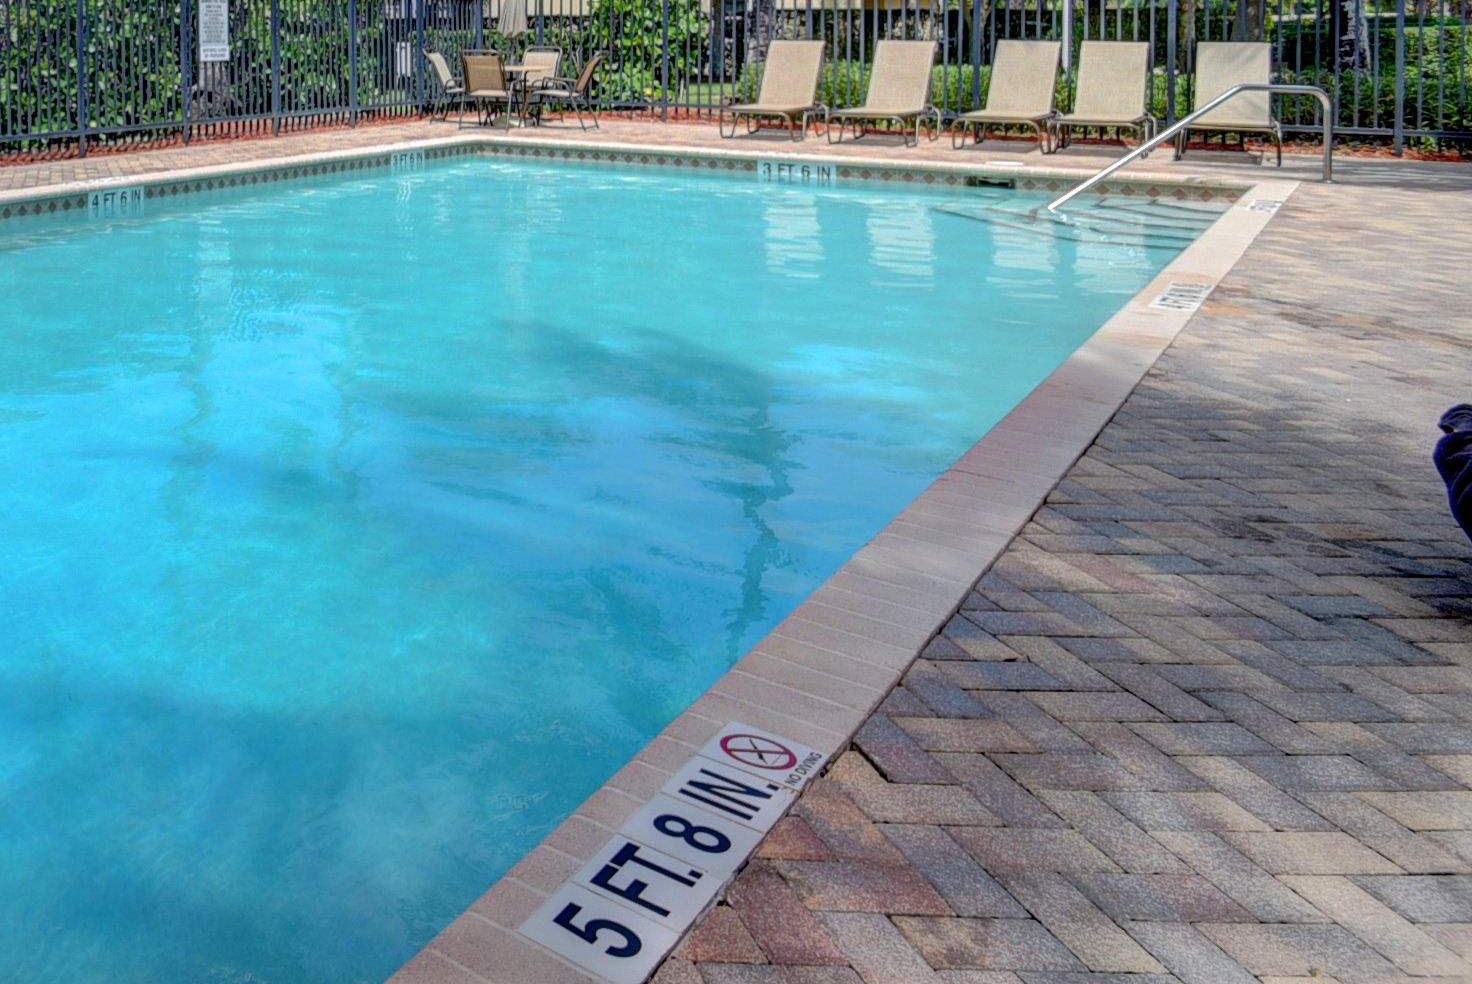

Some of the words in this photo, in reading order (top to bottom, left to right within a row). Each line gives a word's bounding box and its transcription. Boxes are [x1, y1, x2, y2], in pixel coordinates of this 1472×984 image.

[762, 162, 771, 175] 3
[778, 163, 794, 177] FT
[801, 165, 810, 177] 6
[817, 165, 831, 179] IN
[92, 194, 99, 206] 4
[103, 192, 116, 204] FT
[120, 190, 127, 204] 6
[131, 188, 141, 201] IN
[784, 774, 802, 786] NO
[794, 751, 823, 776] DIVING
[552, 901, 643, 958] 5
[652, 813, 731, 854] 8
